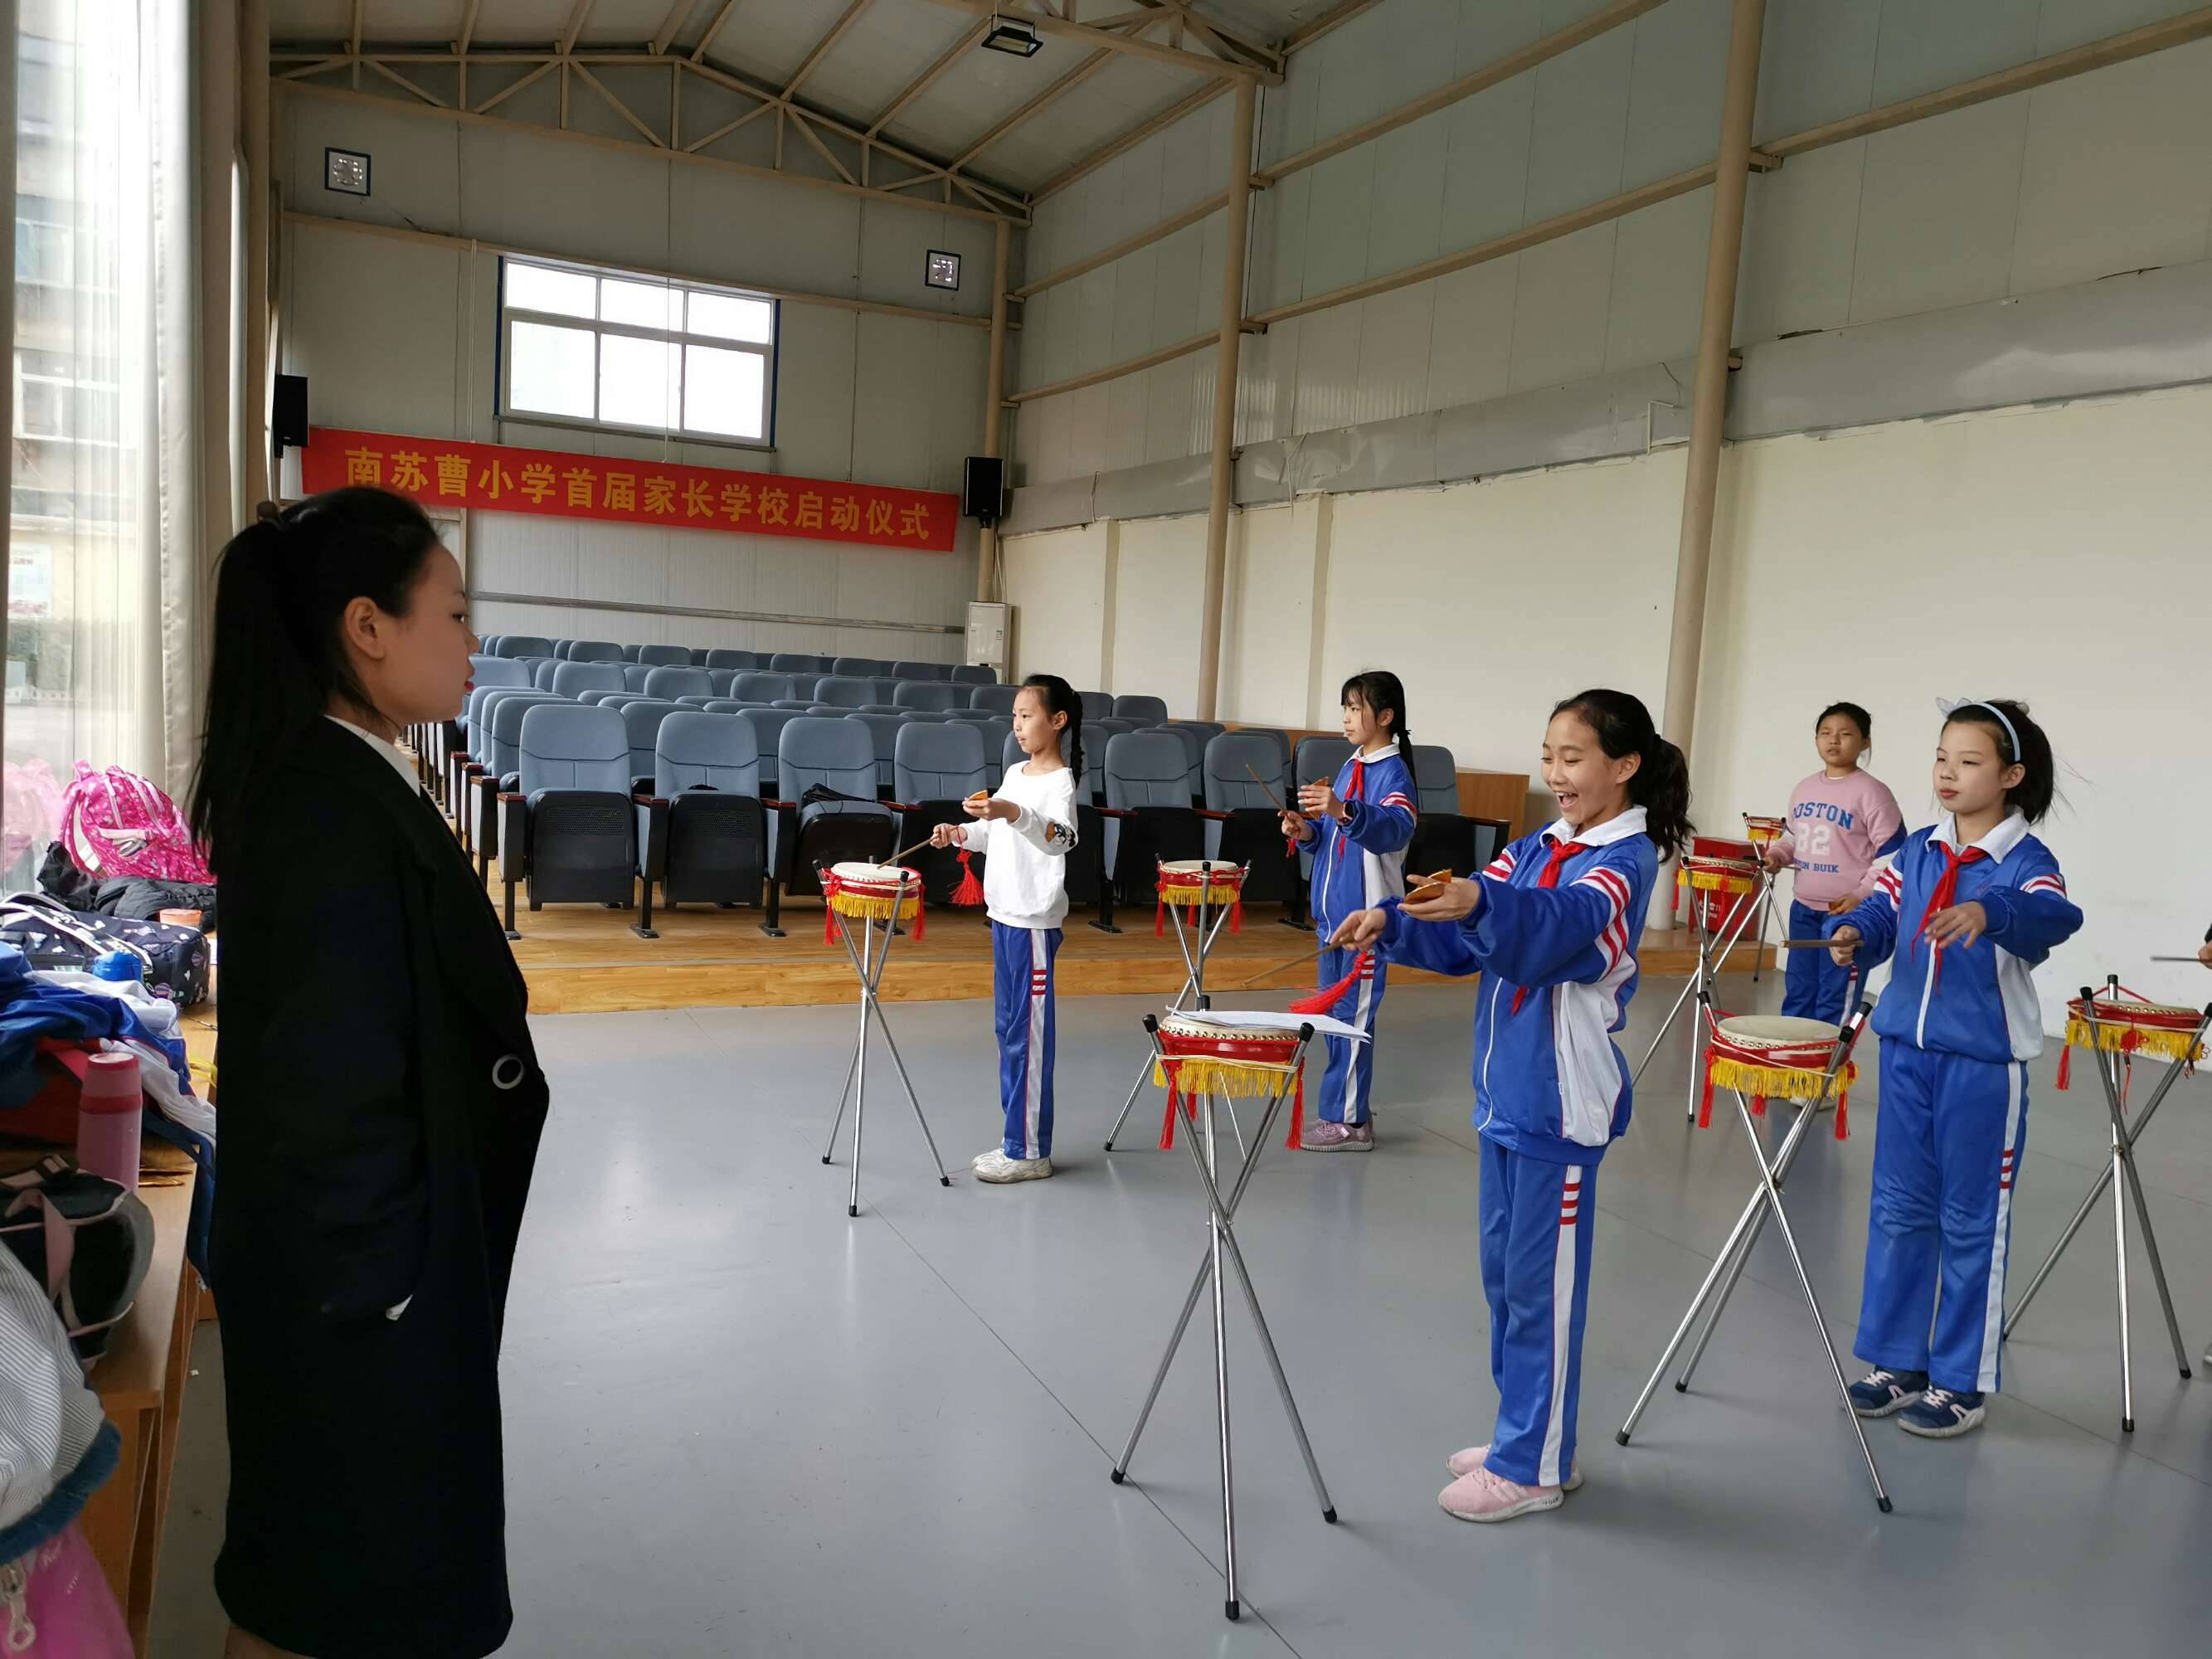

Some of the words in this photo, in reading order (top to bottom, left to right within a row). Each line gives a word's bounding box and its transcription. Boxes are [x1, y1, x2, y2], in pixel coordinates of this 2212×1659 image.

[344, 445, 930, 540] 南苏曹小学首届家长学校启动仪式
[1793, 802, 1854, 830] OSTON
